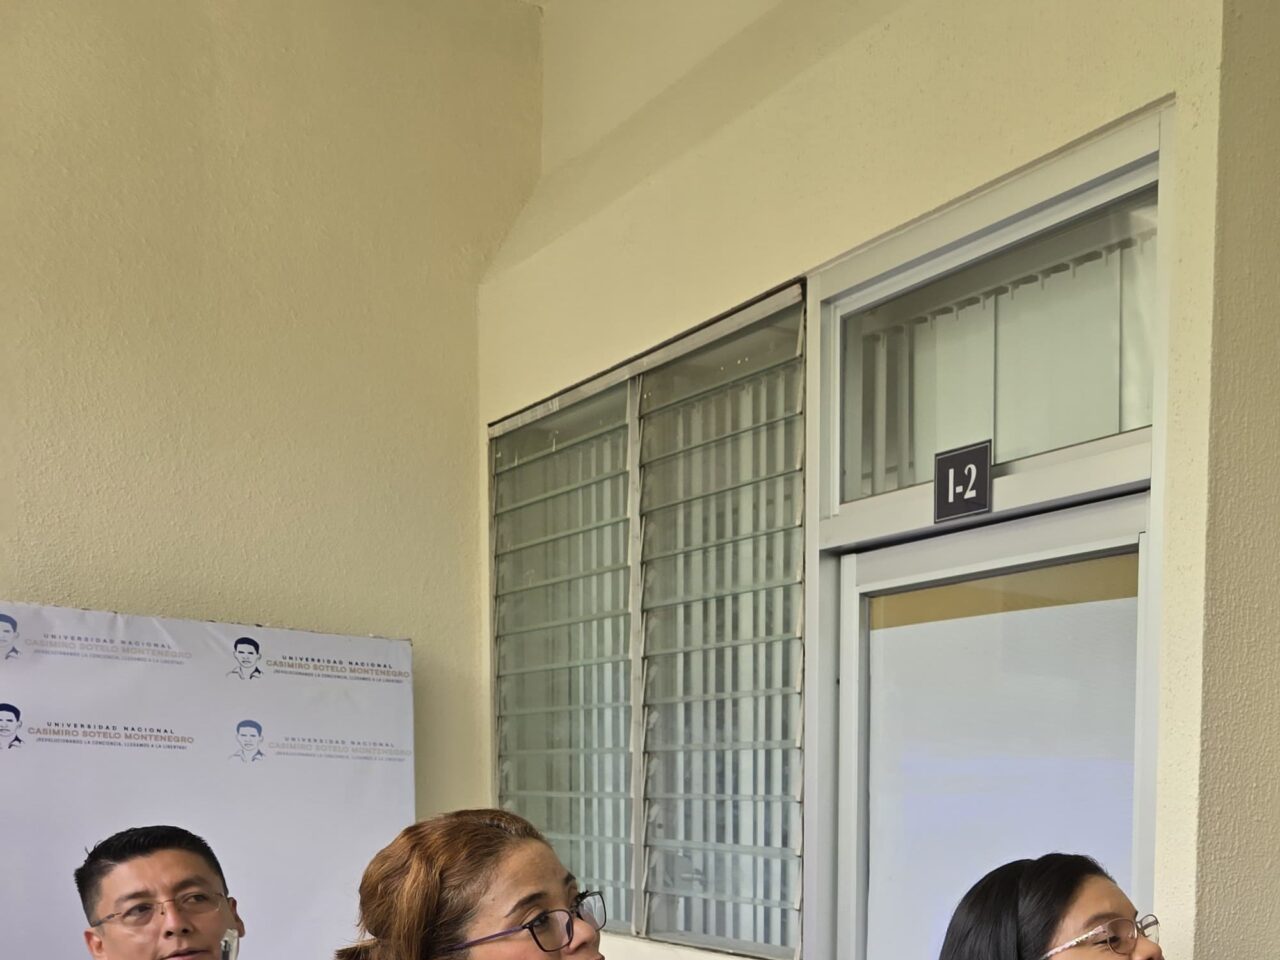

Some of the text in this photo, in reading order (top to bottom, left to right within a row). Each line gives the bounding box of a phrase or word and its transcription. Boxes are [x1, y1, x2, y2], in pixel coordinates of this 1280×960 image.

[43, 633, 172, 650] UNIVERSIDAD NACIONAL
[266, 660, 312, 671] CASIMIRO
[313, 664, 347, 674] SOTELO
[349, 667, 410, 679] MONTENEGRO
[282, 655, 393, 669] UNIVERSIDAD NACIONAL
[27, 726, 194, 744] CASIMIRO SOTELO MONTENEGRO
[46, 721, 175, 735] UNIVERSIDAD NACIONAL
